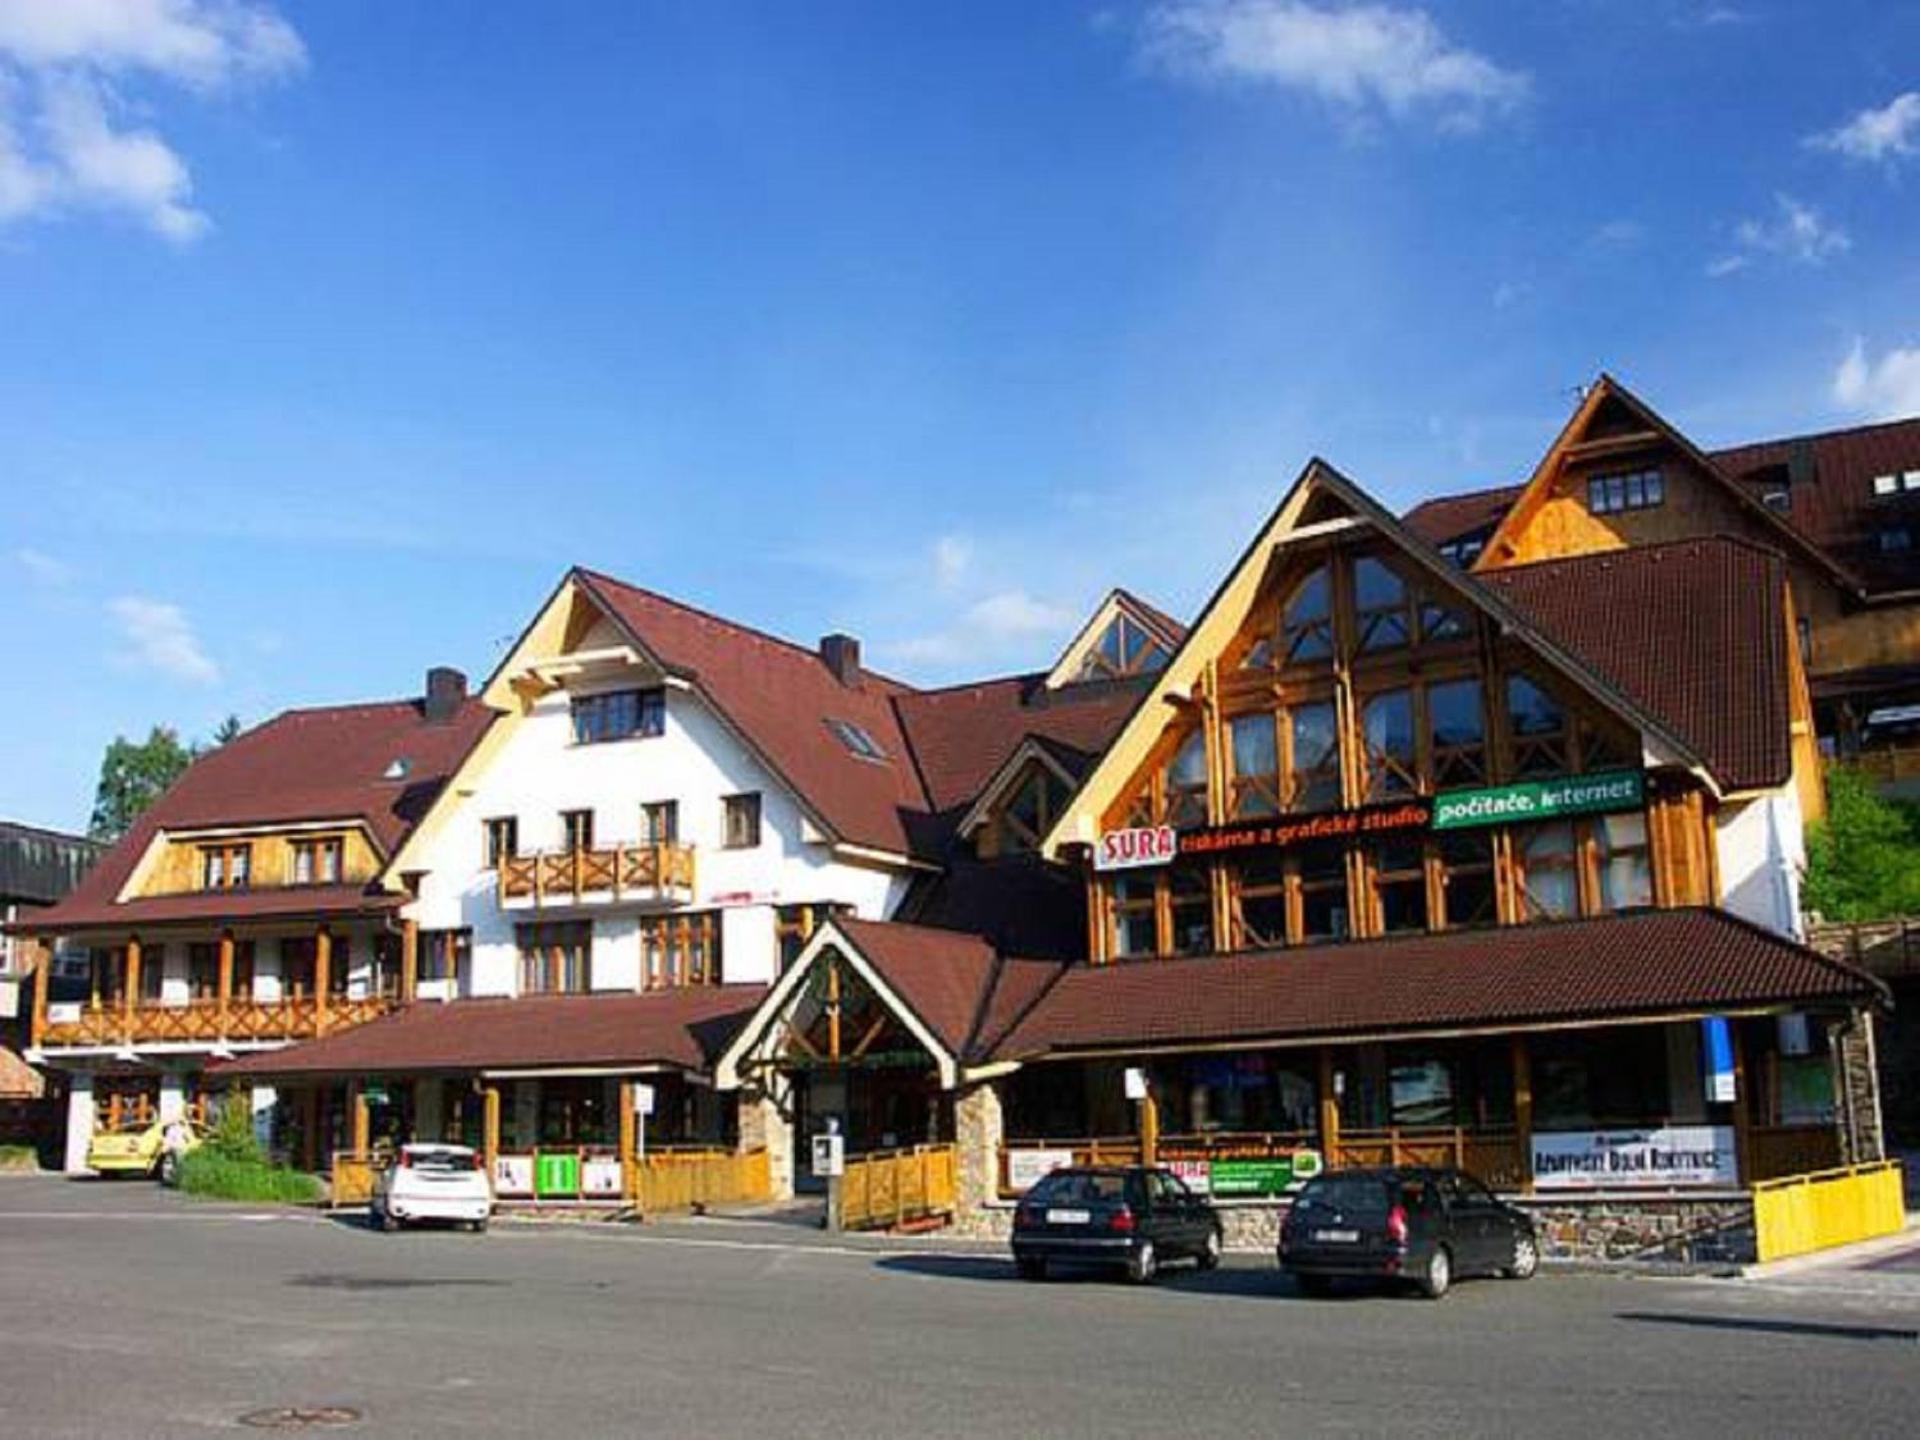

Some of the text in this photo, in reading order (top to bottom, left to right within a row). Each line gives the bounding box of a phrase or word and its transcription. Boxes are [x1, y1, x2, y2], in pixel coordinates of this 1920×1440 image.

[1104, 828, 1172, 860] SURA
[1260, 828, 1271, 843] a
[1276, 812, 1358, 846] grafické
[1362, 803, 1429, 830] studio
